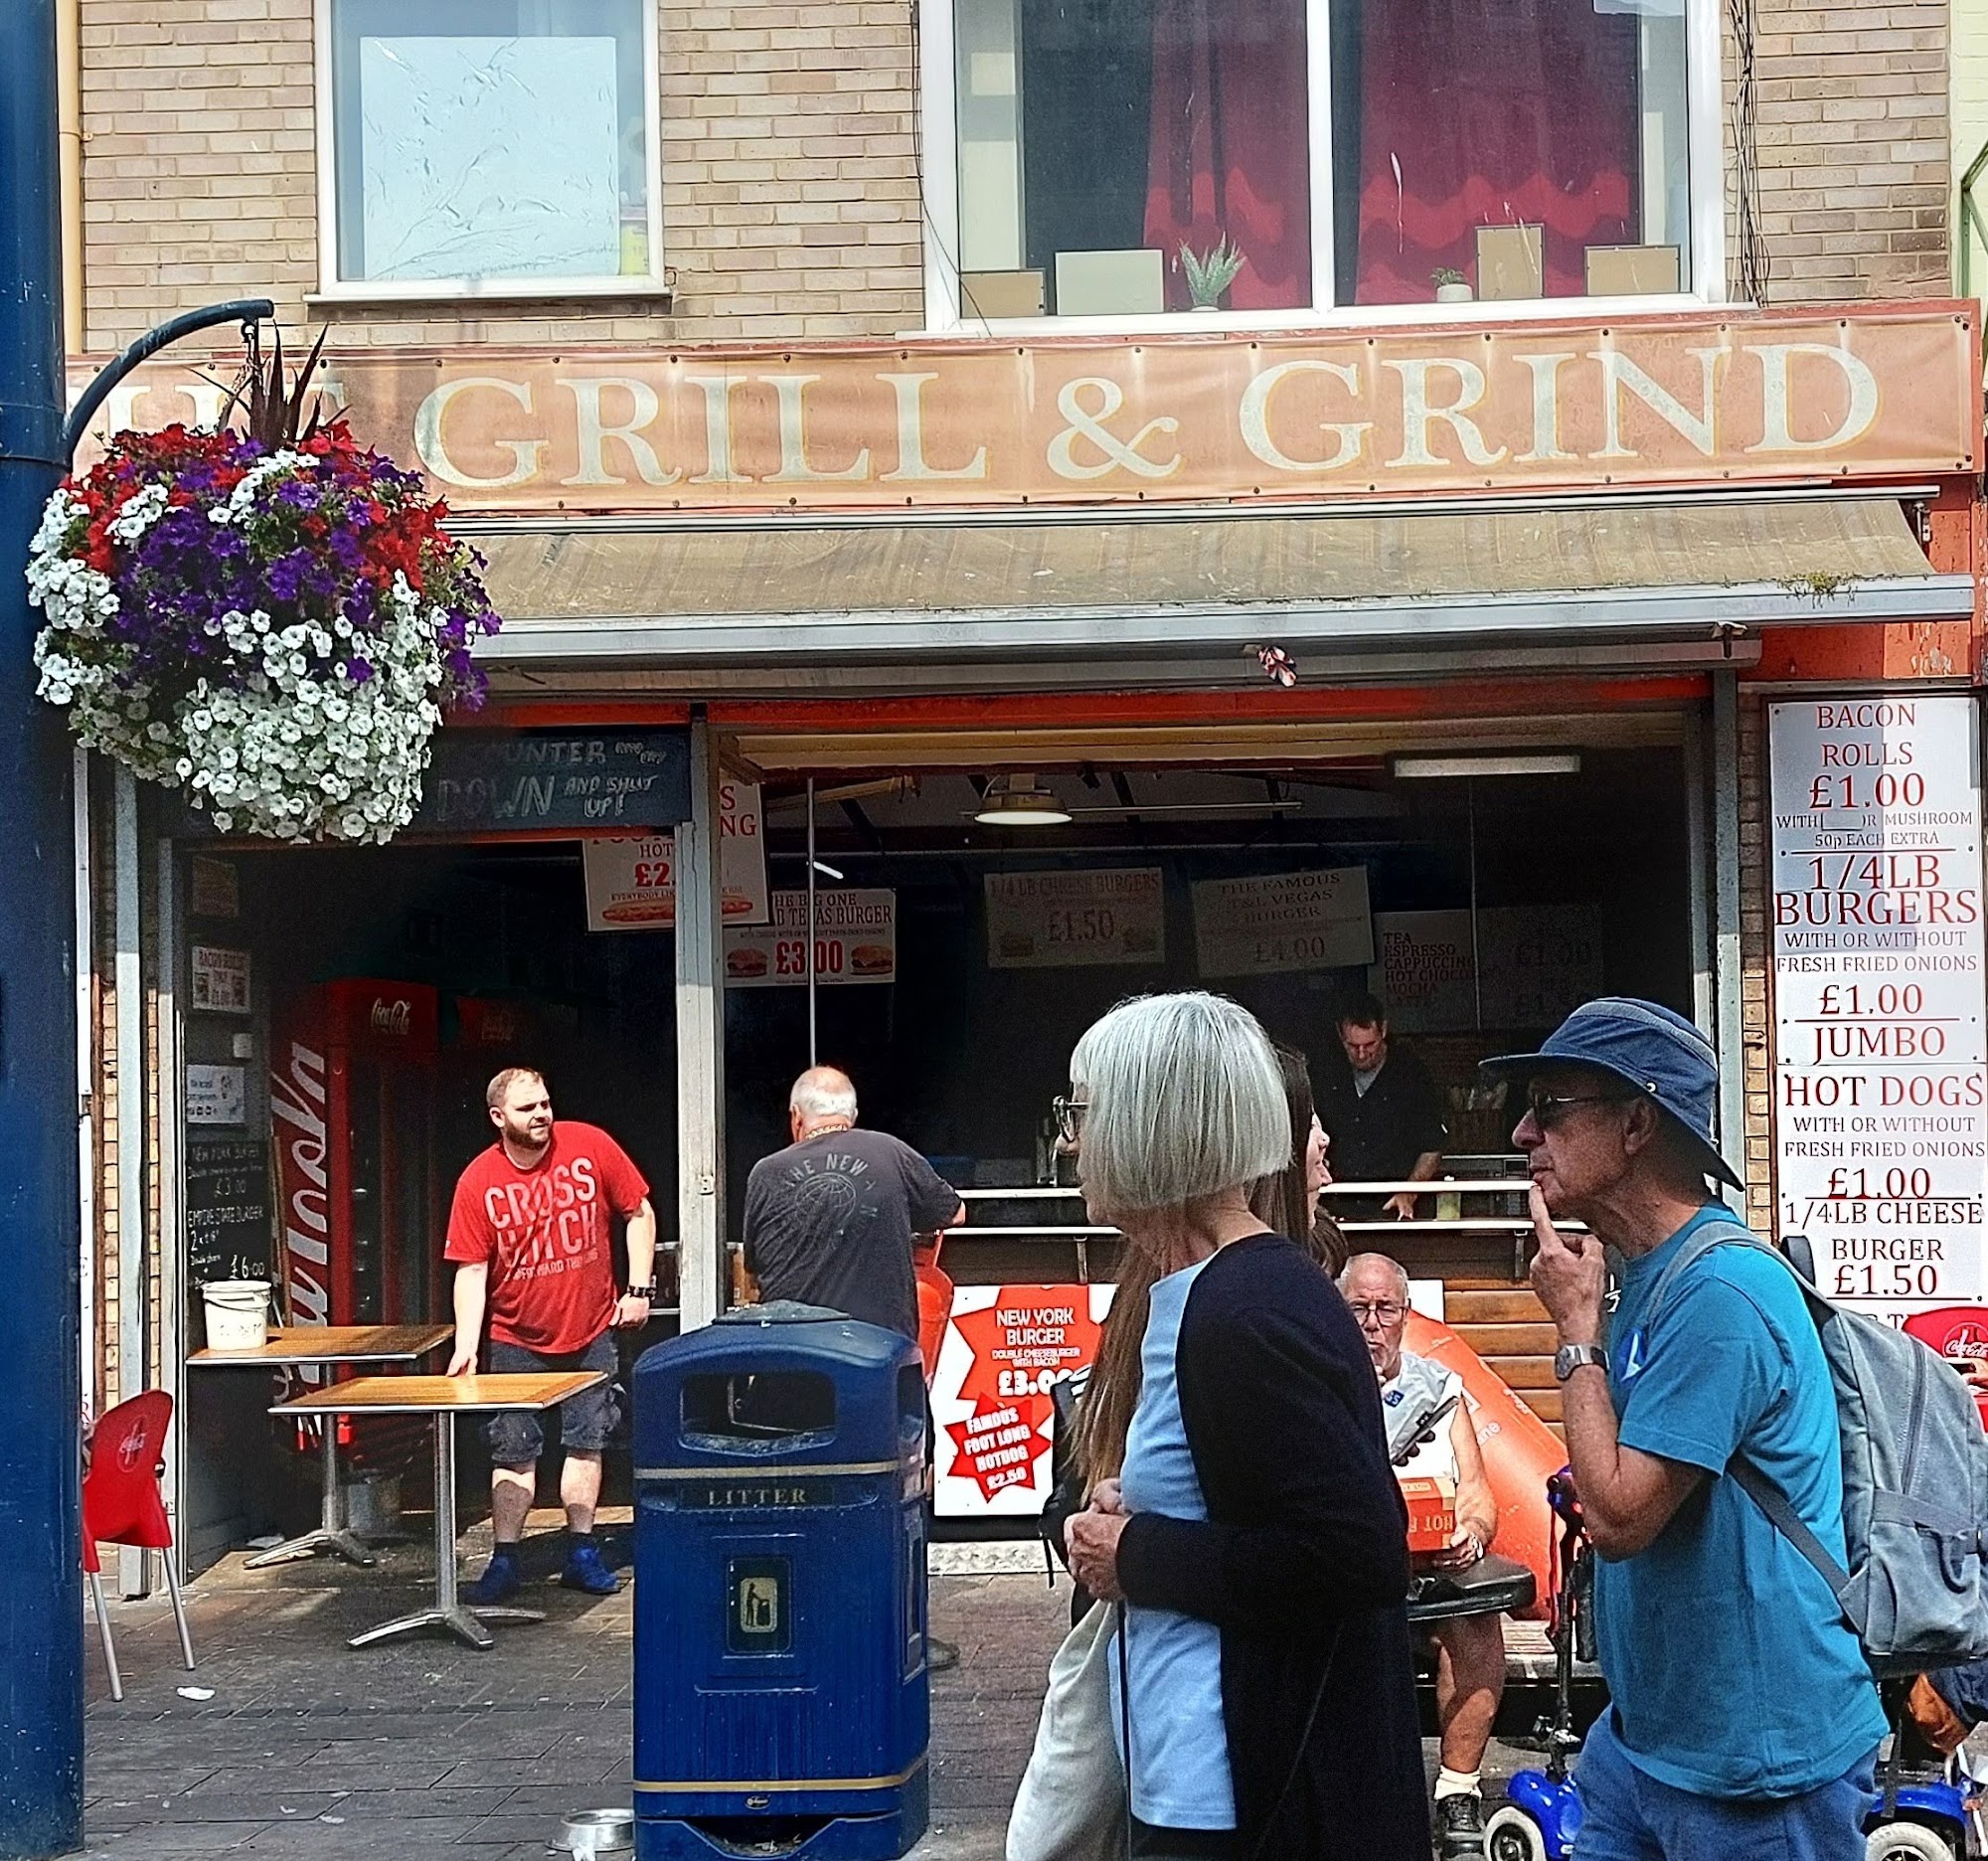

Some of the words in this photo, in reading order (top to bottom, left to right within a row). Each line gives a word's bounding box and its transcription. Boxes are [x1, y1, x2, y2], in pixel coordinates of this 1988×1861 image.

[414, 370, 989, 489] GRILL
[1047, 377, 1184, 479] &
[1239, 342, 1882, 471] GRIND
[1816, 703, 1916, 729] BACON
[1822, 742, 1913, 766] ROLLS
[1809, 772, 1925, 809] £1.00
[1776, 815, 1817, 829] WITH
[1885, 811, 1972, 826] MUSHROOM
[1814, 833, 1842, 850] 50p
[1846, 833, 1885, 847] EACH
[1891, 831, 1939, 845] EXTRA
[1095, 873, 1160, 891] BURGERS
[1261, 873, 1342, 892] FAMOUS
[1809, 854, 1941, 891] 1/4LB
[826, 893, 858, 907] ONE
[1270, 888, 1334, 907] VEGAS
[1775, 890, 1977, 926] BURGERS
[788, 907, 833, 926] TEAS
[836, 904, 893, 925] BURGER
[1048, 909, 1114, 942] £1.50
[1383, 931, 1412, 944] TEA
[1785, 932, 1836, 948] WITH
[1843, 932, 1870, 947] OR
[1875, 930, 1967, 946] WITHOUT
[1384, 943, 1456, 957] ESPRESSO
[1776, 956, 1837, 972] FRESH
[1843, 956, 1899, 972] FRIED
[1905, 955, 1978, 971] ONIONS
[1385, 969, 1415, 983] HOT
[1820, 984, 1923, 1015] £1.00
[1813, 1026, 1946, 1066] JUMBO
[1785, 1076, 1867, 1106] HOT
[1880, 1075, 1984, 1106] DOGS
[1792, 1116, 1845, 1132] WITH
[1851, 1116, 1878, 1132] OR
[1883, 1116, 1976, 1132] WITHOUT
[1785, 1141, 1844, 1157] FRESH
[1851, 1141, 1906, 1157] FRIED
[1912, 1141, 1985, 1157] ONIONS
[825, 1152, 869, 1176] NEW
[483, 1156, 596, 1229] CROSS
[1827, 1167, 1931, 1199] £1.00
[1785, 1202, 1868, 1230] 1/4LB
[1877, 1202, 1984, 1225] CHEESE
[1831, 1239, 1944, 1261] BURGER
[1833, 1265, 1938, 1296] £1.50
[995, 1308, 1031, 1328] NEW
[1033, 1306, 1076, 1326] YORK
[1005, 1327, 1066, 1346] BURGER
[965, 1407, 1020, 1436] FAMOUS
[963, 1433, 996, 1456] FOOT
[996, 1423, 1032, 1445] LONG
[974, 1444, 1030, 1473] HOTDOG
[986, 1466, 1028, 1491] £2.50
[708, 1487, 808, 1507] LITTER
